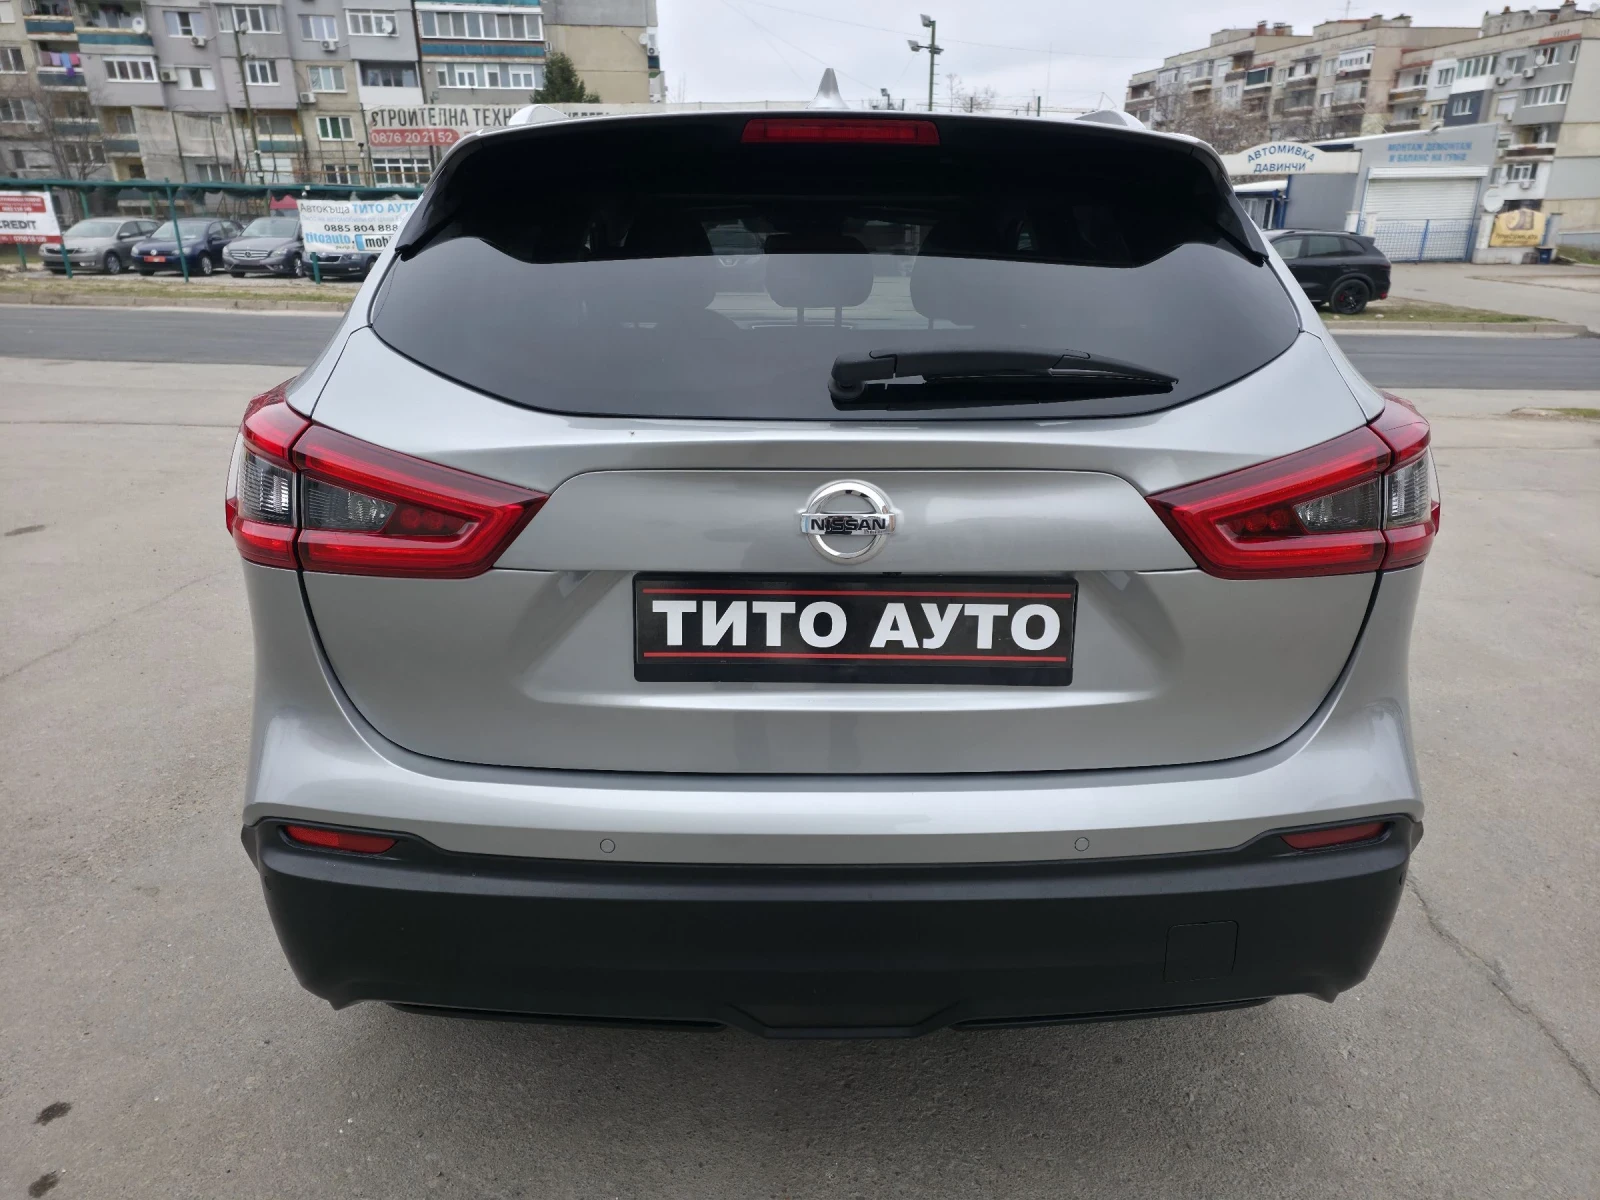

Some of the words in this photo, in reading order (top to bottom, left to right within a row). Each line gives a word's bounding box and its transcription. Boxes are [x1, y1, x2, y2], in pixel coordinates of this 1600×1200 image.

[371, 131, 402, 143] 0876
[405, 131, 420, 143] 20
[422, 131, 435, 143] 21
[438, 131, 453, 143] 52
[1247, 144, 1315, 163] АВТОМИВКА
[1253, 162, 1306, 173] ДАВИНЧИ
[300, 203, 350, 214] Автокъща
[352, 203, 384, 214] ТИТО
[324, 224, 351, 232] 0885
[353, 224, 375, 232] 804
[377, 224, 399, 232] 888
[365, 236, 392, 247] mob
[810, 518, 886, 531] NISSAN
[651, 599, 848, 648] ТИТО
[869, 602, 1062, 651] АУТО
